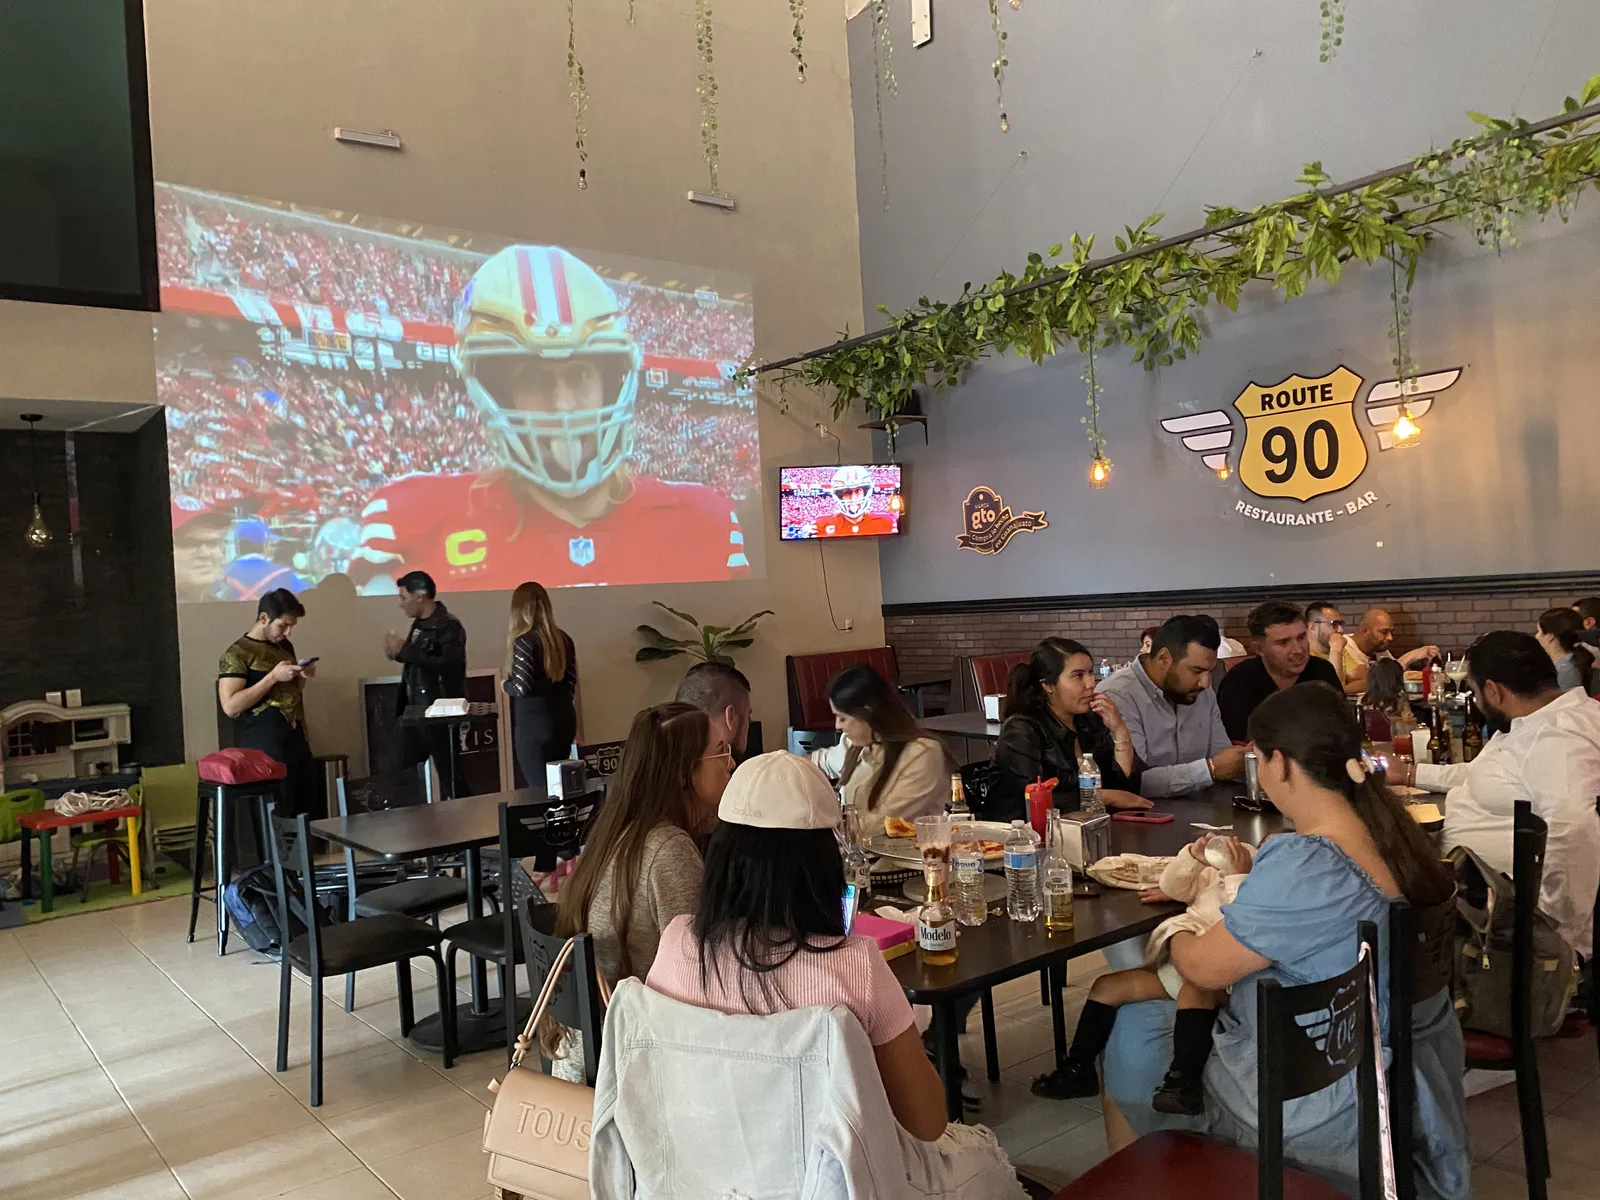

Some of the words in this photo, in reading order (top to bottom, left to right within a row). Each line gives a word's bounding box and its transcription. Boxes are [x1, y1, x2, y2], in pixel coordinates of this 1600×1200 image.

[1261, 383, 1333, 411] ROUTE
[1262, 419, 1339, 484] 90
[971, 508, 996, 530] gto
[1235, 500, 1334, 526] RESTAURANTE
[1345, 490, 1379, 515] BAR
[972, 534, 993, 542] Compra
[994, 513, 1010, 529] hecho
[995, 539, 1003, 548] en
[1000, 520, 1032, 540] Guanajuato
[445, 529, 487, 566] C
[603, 758, 618, 771] 90
[920, 926, 952, 941] Modelo
[516, 1101, 592, 1153] TOUS
